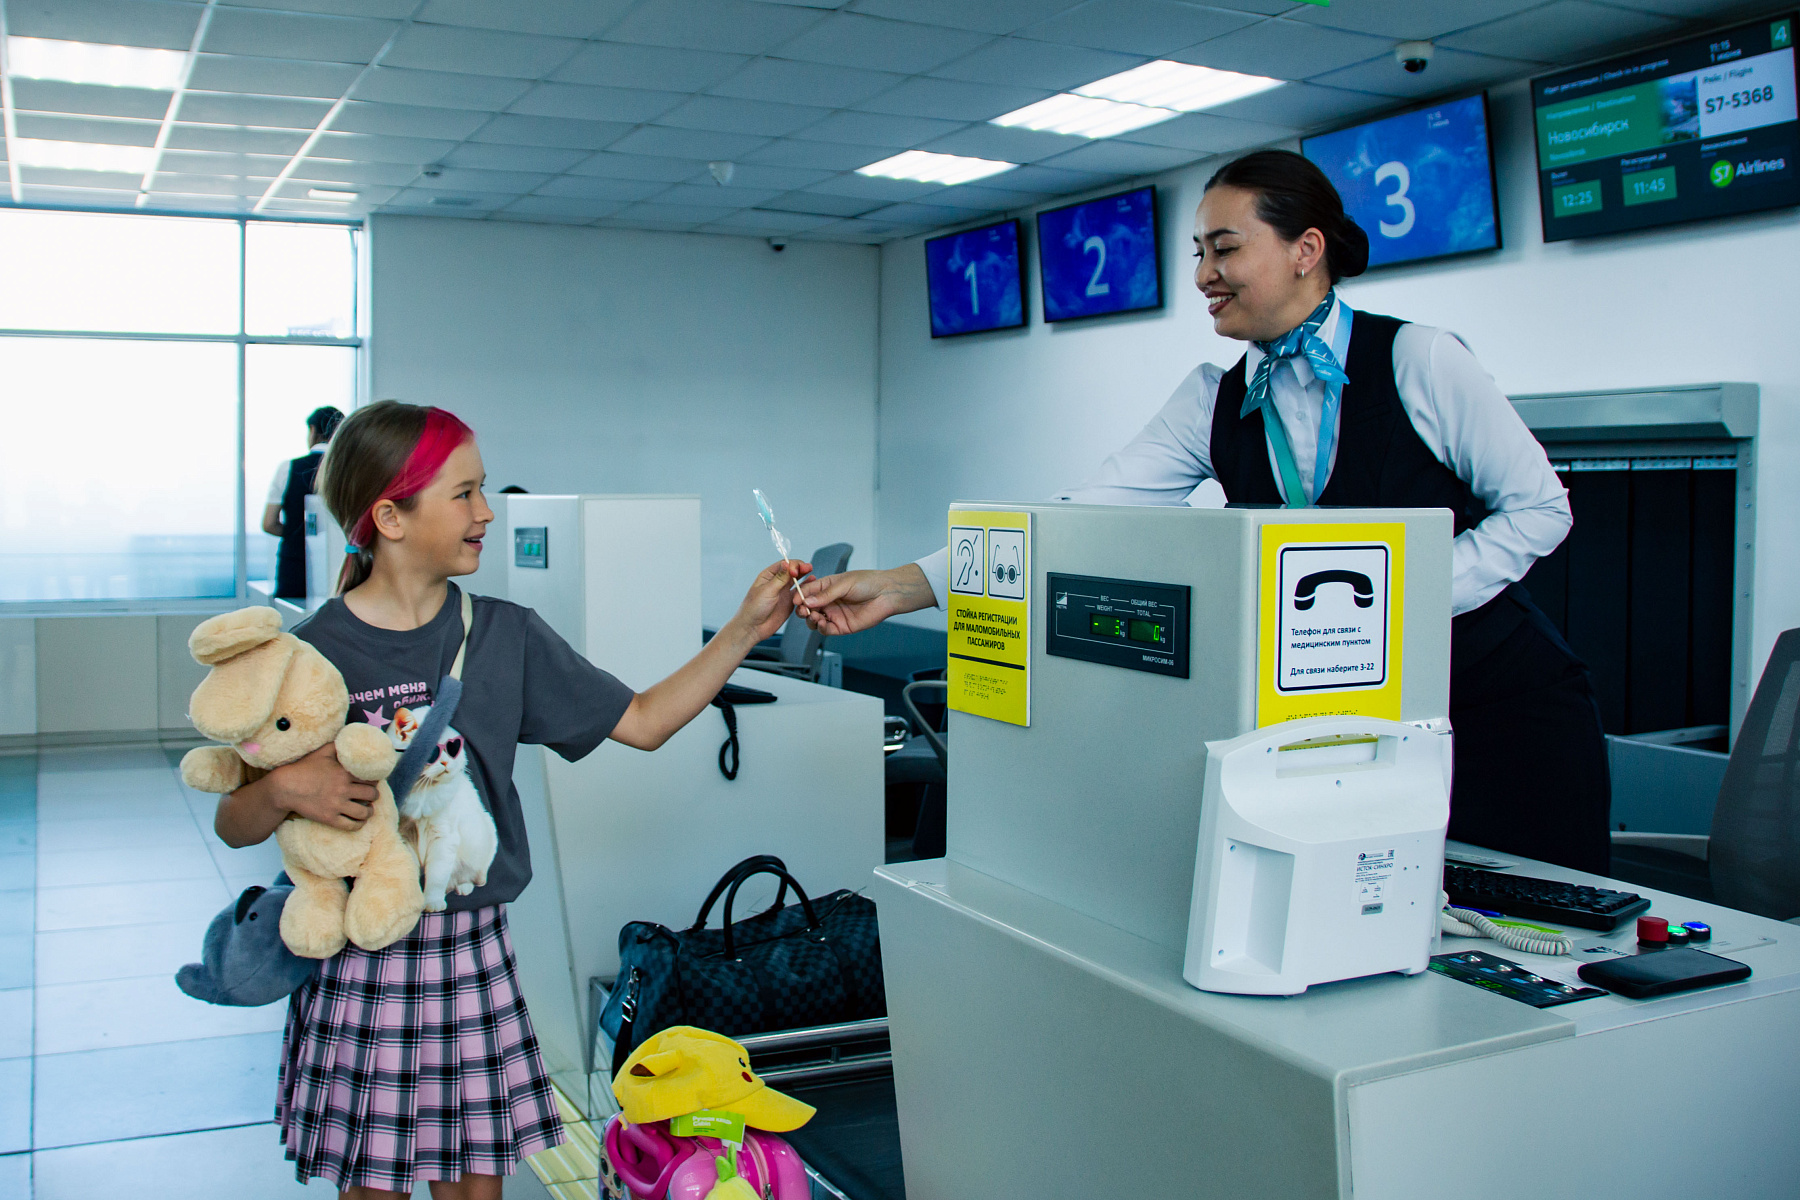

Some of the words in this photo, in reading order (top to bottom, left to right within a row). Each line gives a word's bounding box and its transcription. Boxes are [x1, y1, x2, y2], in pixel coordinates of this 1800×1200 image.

[1775, 26, 1787, 42] 4
[1705, 84, 1774, 114] S7-5368
[1548, 119, 1629, 146] Новосибирск
[1714, 164, 1730, 184] S7
[1736, 158, 1786, 177] Airlines
[1634, 178, 1666, 196] 11:45
[1374, 160, 1416, 238] 3
[1562, 190, 1593, 208] 12:25
[1082, 236, 1110, 297] 2
[964, 261, 979, 316] 1
[956, 608, 977, 620] СТОЙКА
[978, 612, 1018, 625] РЕГИСТРАЦИИ
[1096, 604, 1113, 612] WEIGHT
[954, 622, 965, 631] ДЛЯ
[966, 624, 1020, 639] МАЛОМОБИЛЬНЫХ
[1120, 630, 1126, 638] kg
[1291, 628, 1321, 636] Телефон
[967, 636, 1005, 650] ПАССАЖИРОВ
[1291, 640, 1340, 649] медицинским
[1342, 639, 1371, 647] пунктом
[1290, 668, 1304, 677] Для
[1327, 664, 1358, 673] наберите
[1360, 662, 1374, 670] 3-22
[349, 688, 385, 704] ачем
[388, 682, 426, 698] меня
